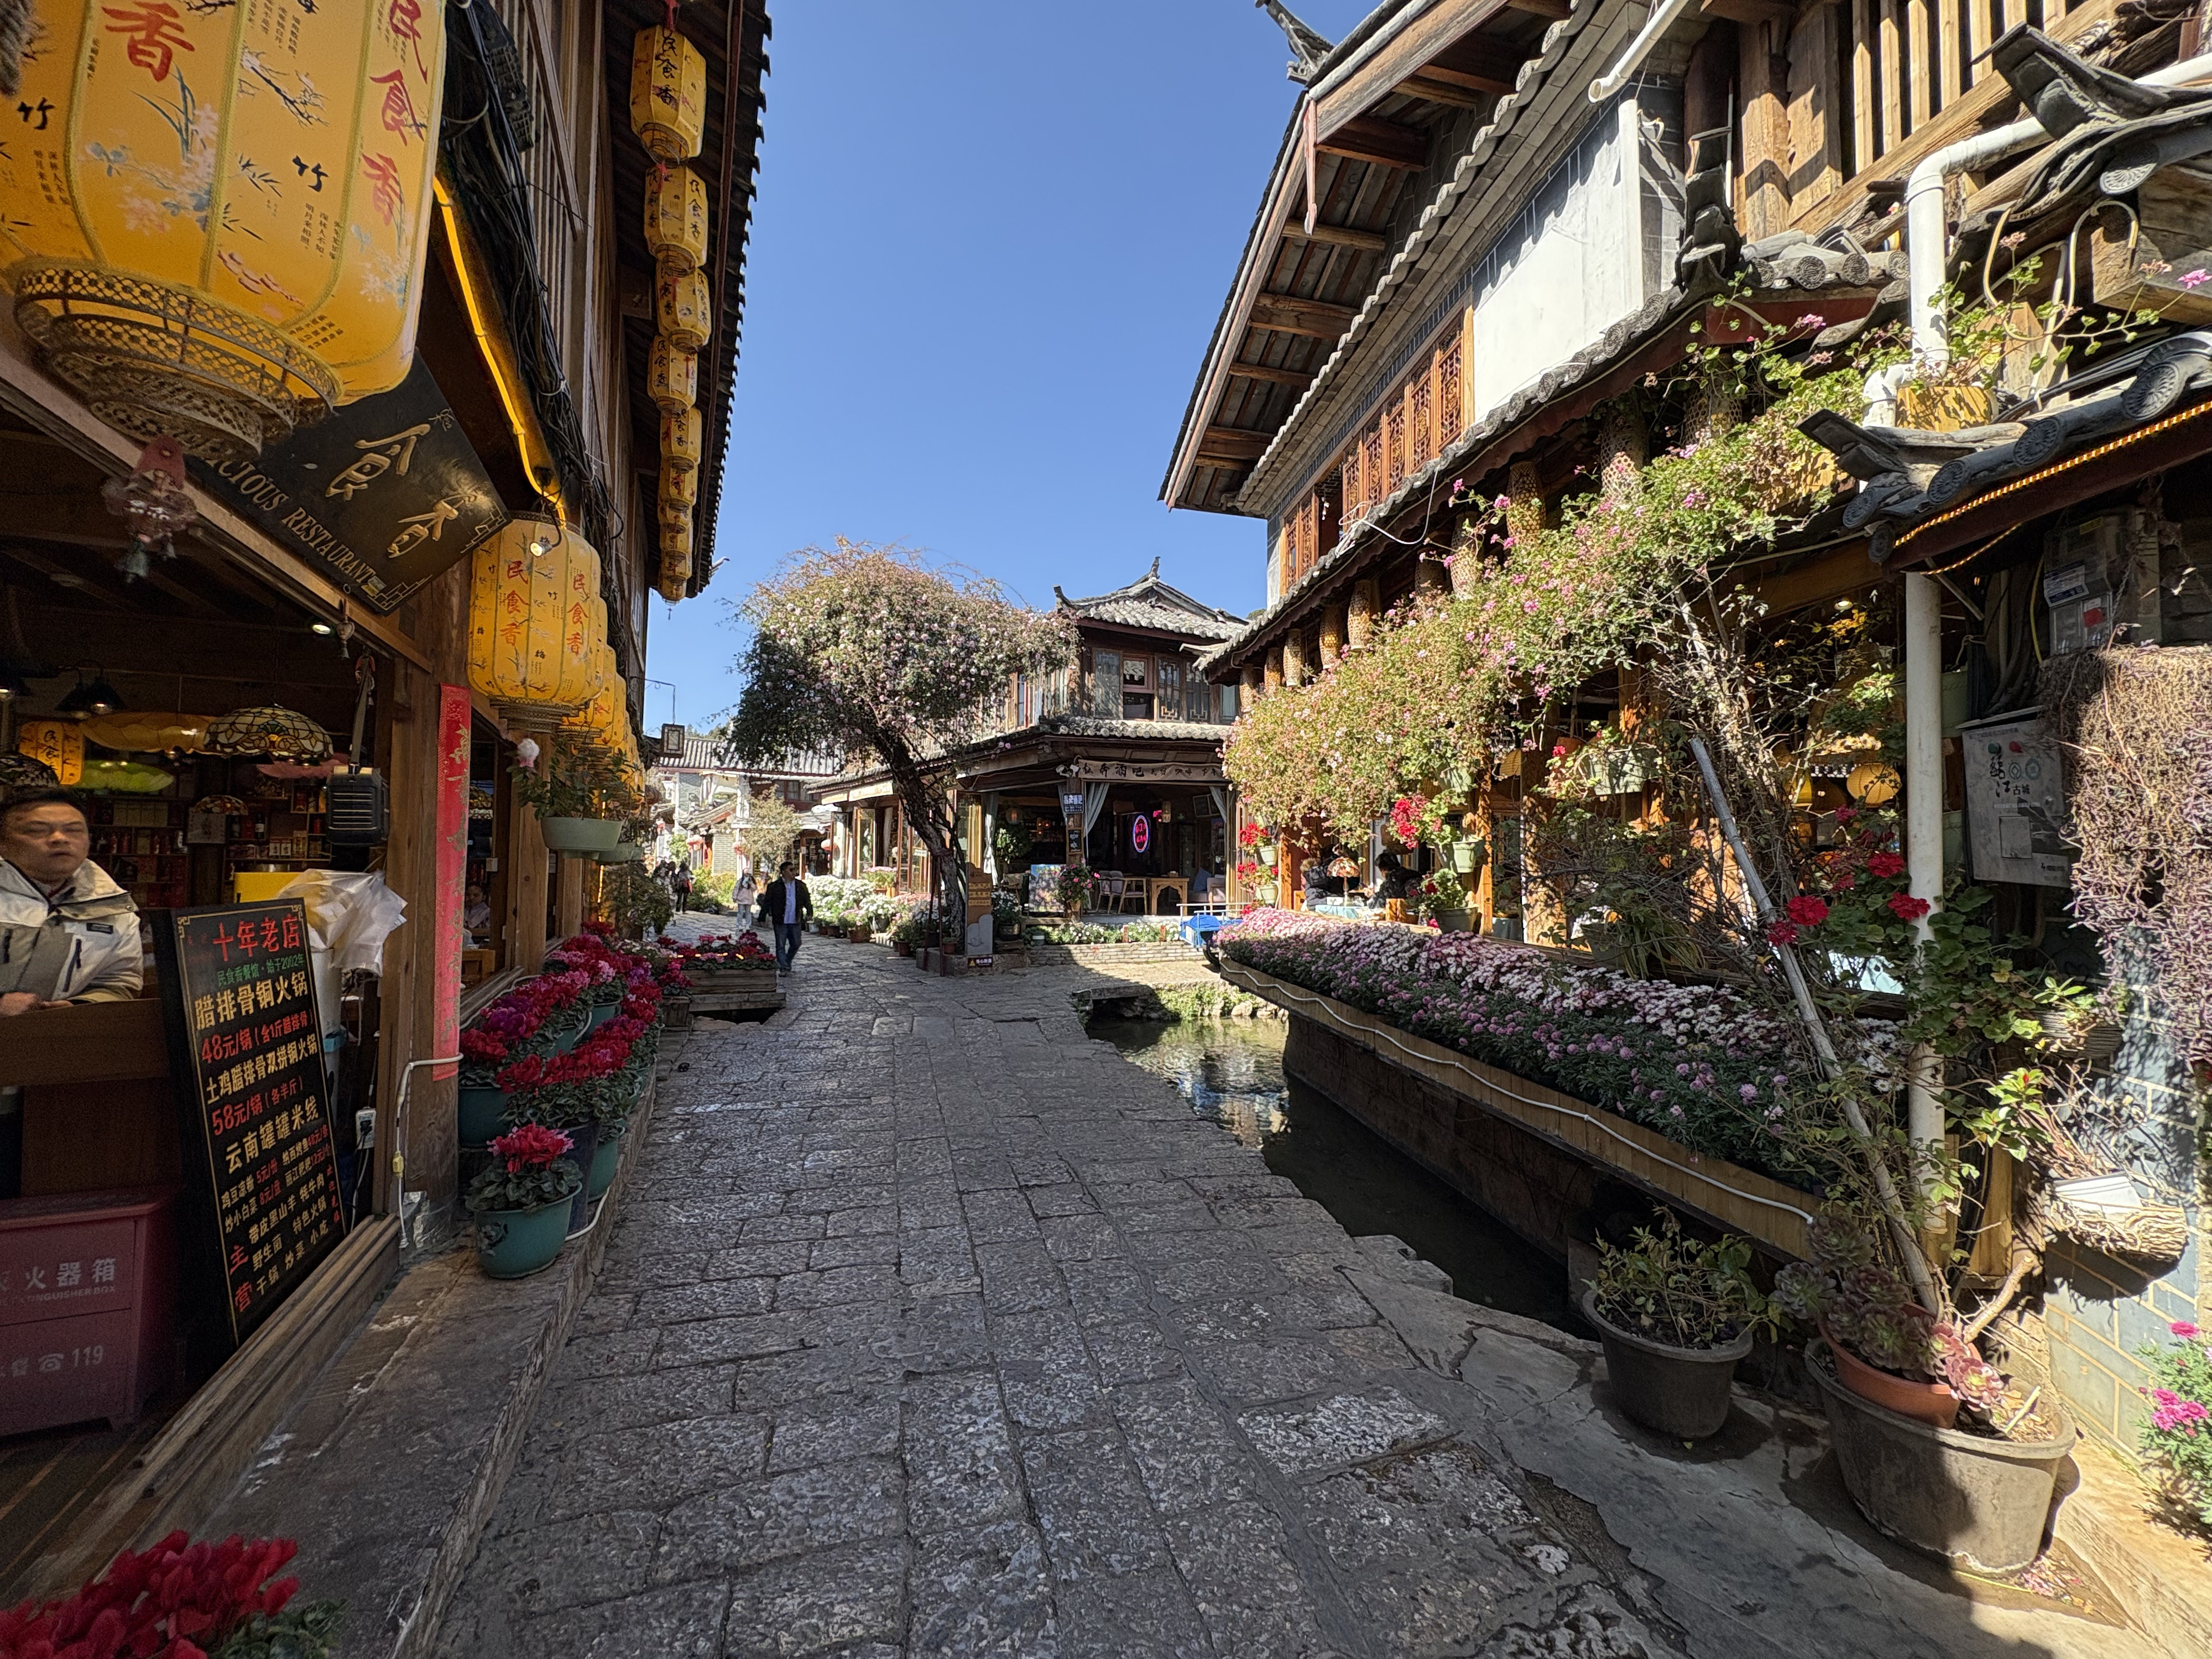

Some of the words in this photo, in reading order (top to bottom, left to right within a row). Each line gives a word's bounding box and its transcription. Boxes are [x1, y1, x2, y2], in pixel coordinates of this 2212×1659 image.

[102, 1, 195, 82] 香
[659, 37, 678, 105] 民食香
[17, 97, 55, 130] 竹
[292, 155, 329, 192] 竹
[281, 507, 377, 585] RESTAURANT
[500, 560, 529, 646] 民食香
[567, 573, 589, 656] 民食香
[212, 914, 300, 962] 十年老店
[195, 971, 309, 1030] 腊排骨铜火锅
[206, 1033, 317, 1105] 土鸡腊排骨双拼铜火锅
[226, 1095, 319, 1175] 云南罐罐米线
[221, 1174, 254, 1209] 鸡豆凉粉
[249, 1194, 297, 1244] 带皮黑山羊
[253, 1233, 283, 1271] 野生菌
[293, 1194, 327, 1234] 特色火锅
[230, 1245, 252, 1312] 主营
[72, 1344, 104, 1368] 119
